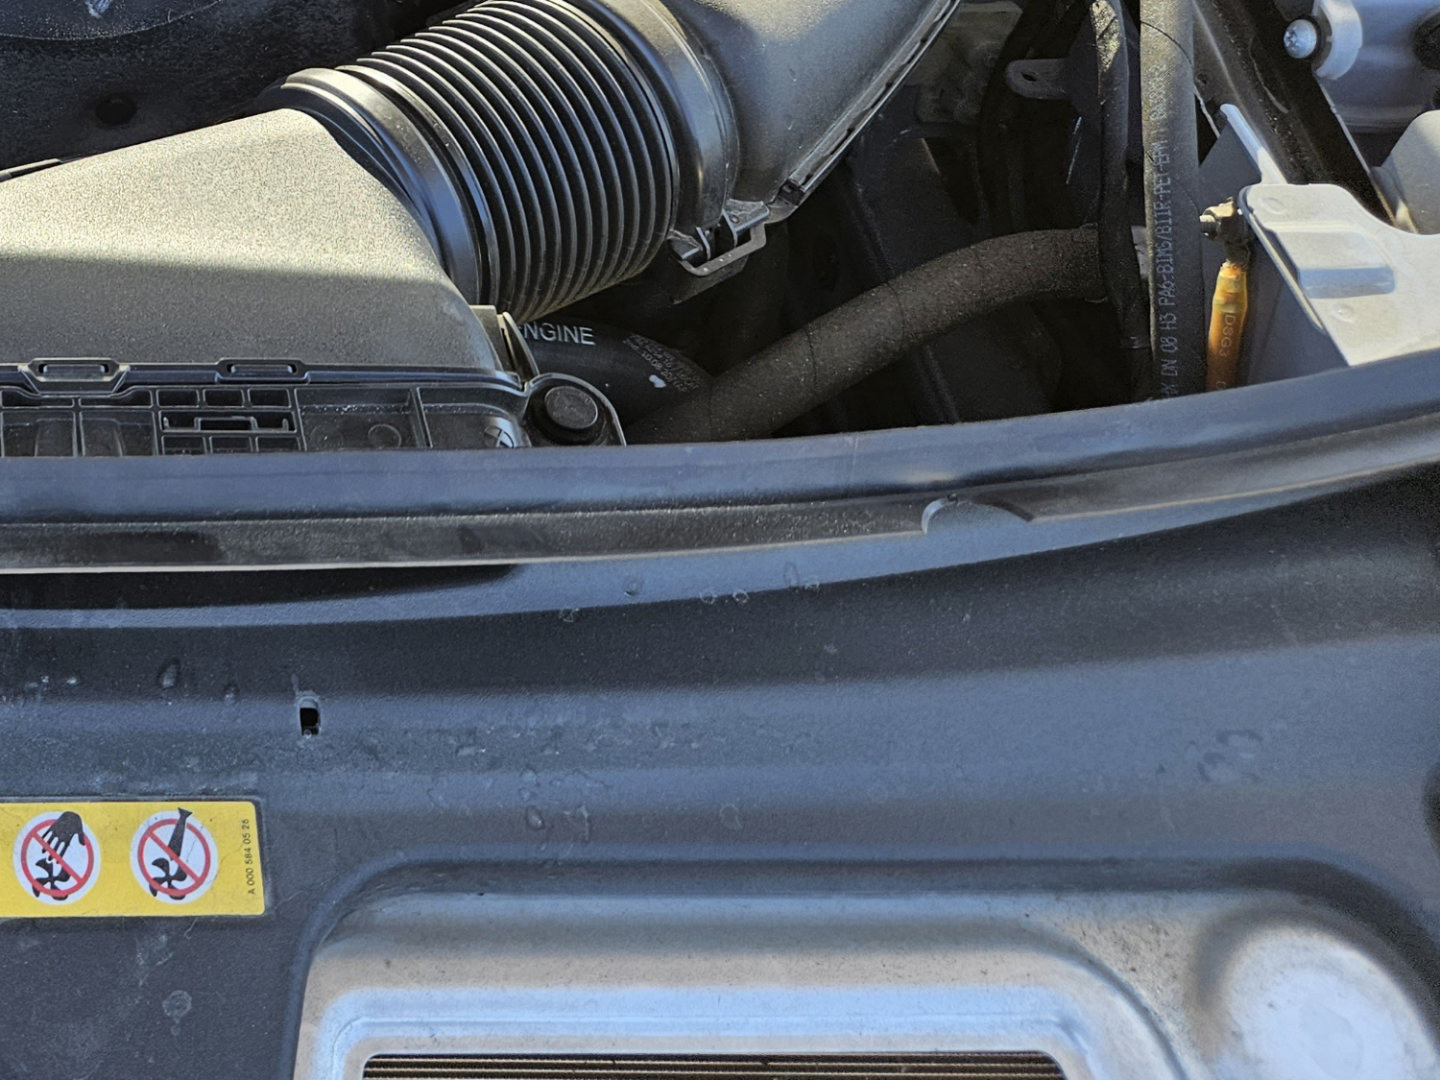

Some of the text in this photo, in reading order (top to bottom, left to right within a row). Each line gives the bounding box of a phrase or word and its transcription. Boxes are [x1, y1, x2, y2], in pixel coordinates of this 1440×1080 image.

[519, 321, 596, 346] NGINE
[242, 832, 251, 845] 05
[243, 847, 253, 865] 584
[245, 867, 255, 886] 000
